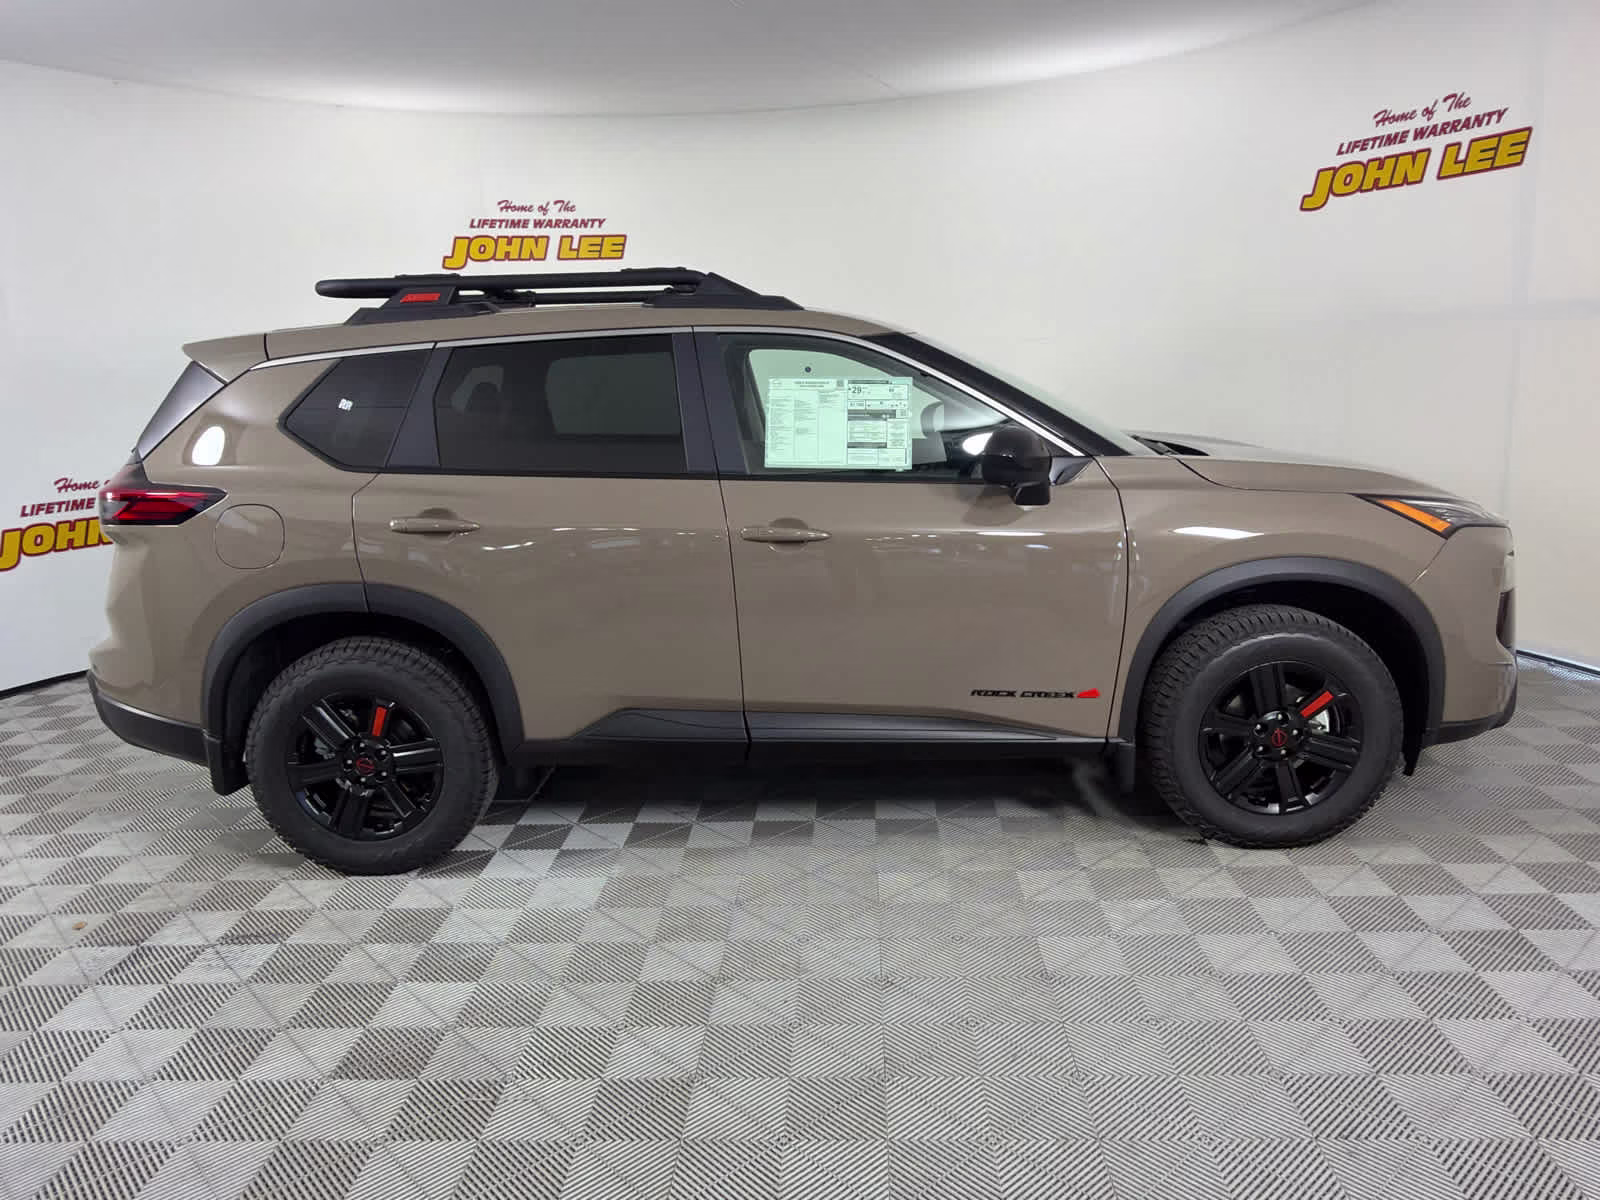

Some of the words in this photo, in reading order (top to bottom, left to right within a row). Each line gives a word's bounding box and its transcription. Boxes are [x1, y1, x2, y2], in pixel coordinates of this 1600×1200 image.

[1372, 109, 1418, 128] Home
[1421, 99, 1439, 121] of
[1443, 92, 1471, 112] The
[1336, 130, 1410, 156] LIFETIME
[1412, 107, 1509, 142] WARRANTY
[1299, 148, 1432, 211] JOHN
[1436, 126, 1533, 180] LEE
[497, 199, 534, 213] Home
[537, 201, 550, 216] of
[553, 199, 576, 213] The
[469, 218, 531, 229] LIFETIME
[533, 218, 606, 229] WARRANTY
[442, 235, 550, 270] JOHN
[557, 234, 627, 261] LEE
[53, 477, 100, 493] Home
[20, 497, 96, 518] LIFETIME
[970, 689, 1017, 698] ROCK
